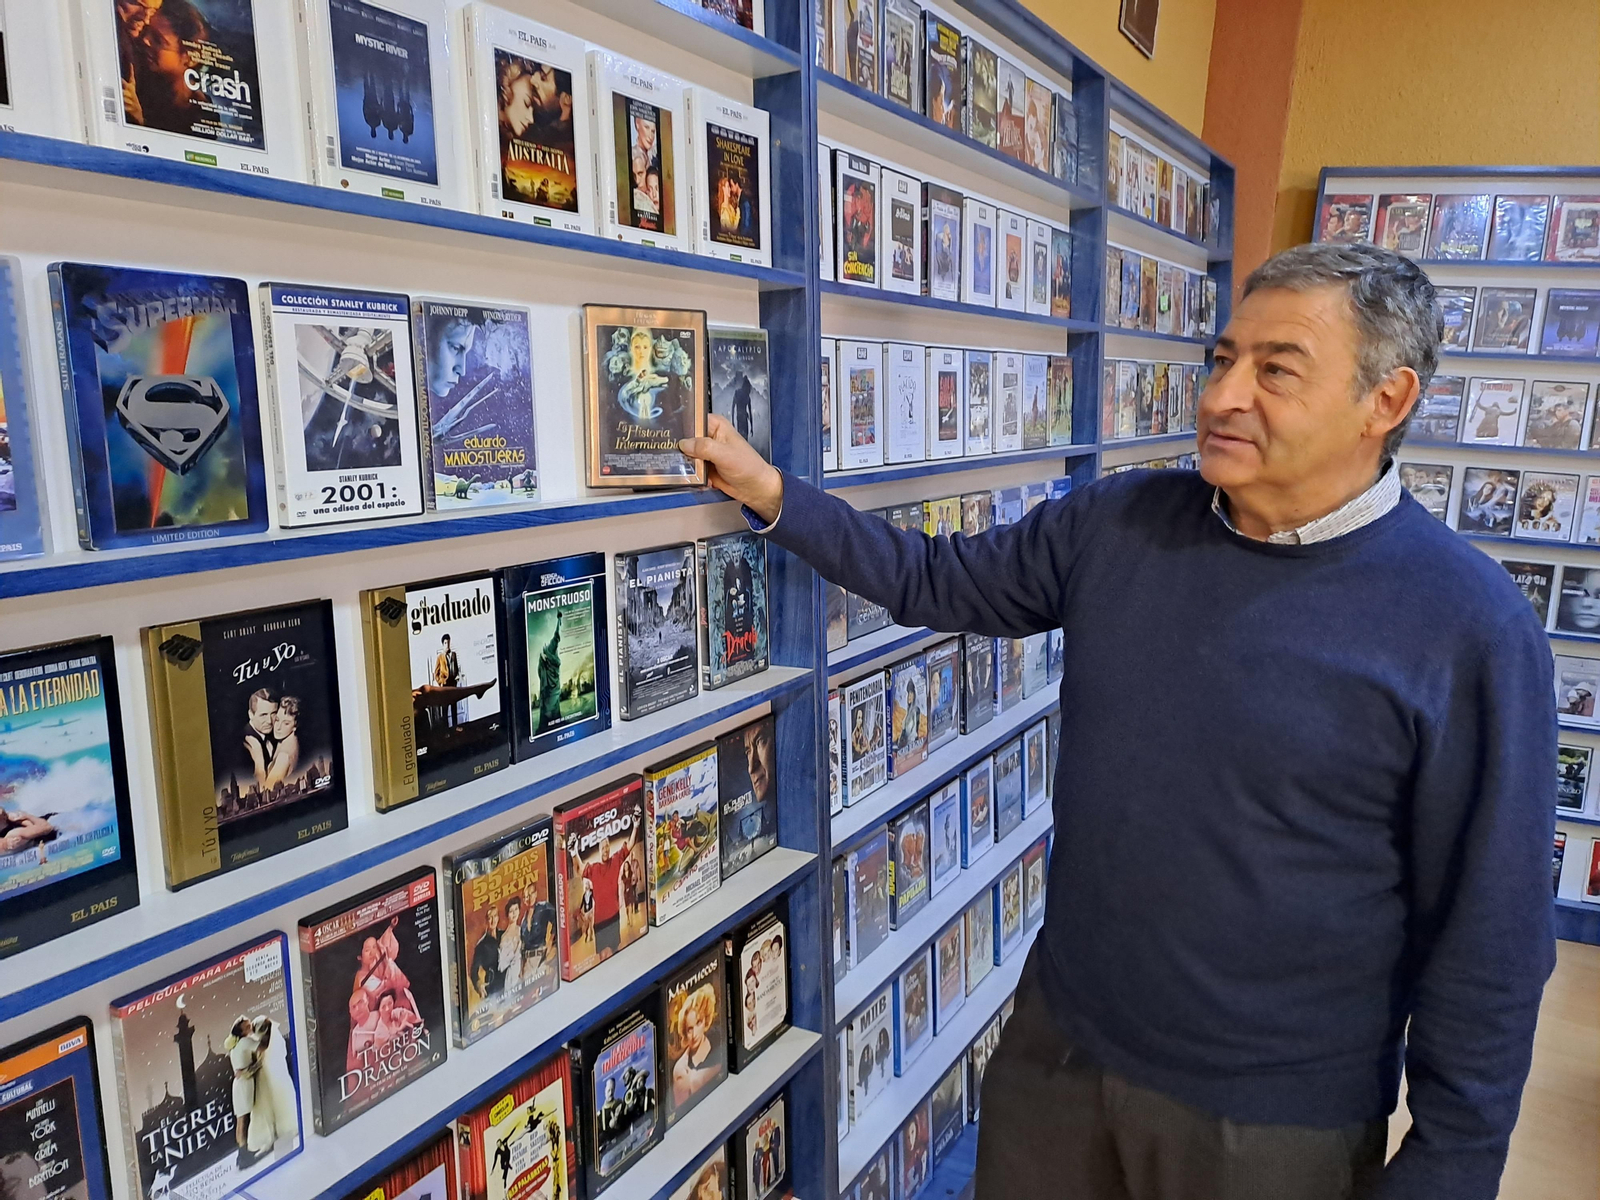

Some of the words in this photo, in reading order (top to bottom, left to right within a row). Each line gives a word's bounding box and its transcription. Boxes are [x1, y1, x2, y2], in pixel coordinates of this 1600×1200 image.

[355, 33, 385, 52] MYSTIC
[386, 43, 408, 59] RIVER
[518, 30, 529, 42] EL
[184, 69, 251, 103] crash
[240, 163, 251, 172] EL
[507, 140, 570, 176] AUSTRALIA
[281, 295, 329, 306] COLECCIÓN
[331, 300, 364, 309] STANLEY
[366, 301, 398, 312] KUBRICK
[429, 304, 454, 317] JOHNNY
[453, 307, 468, 317] DEPP
[81, 293, 237, 354] SUPERMAN
[54, 321, 70, 391] SUPERMAN
[464, 434, 507, 449] eduardo
[321, 482, 397, 505] 2001:
[313, 506, 330, 515] una
[332, 504, 360, 513] odisea
[362, 502, 375, 510] del
[377, 498, 405, 511] espacio
[152, 532, 185, 543] LIMITED
[187, 529, 220, 539] EDITION
[629, 578, 642, 588] EL
[647, 566, 693, 586] PIANISTA
[411, 588, 491, 635] graduado
[528, 590, 590, 613] MONSTRUOSO
[262, 657, 270, 670] y
[9, 684, 29, 715] LA
[30, 669, 100, 711] ETERNIDAD
[849, 679, 882, 706] PENITENCIARIA
[401, 715, 416, 772] graduado
[315, 775, 331, 787] DVD
[403, 776, 415, 786] El
[473, 765, 484, 775] EL
[658, 782, 676, 800] GENE
[675, 774, 692, 793] KELLY
[594, 808, 617, 828] PESO
[297, 828, 310, 839] EL
[532, 828, 549, 842] DVD
[581, 814, 631, 852] PESADO
[472, 868, 502, 898] 55
[504, 850, 539, 876] DIAS
[513, 865, 532, 879] EN
[413, 881, 430, 895] DVD
[473, 870, 539, 912] PEKIN
[899, 879, 926, 908] PAPILLON
[71, 909, 88, 923] EL
[90, 896, 118, 915] PAIS
[314, 928, 322, 937] 4
[322, 920, 340, 934] OSCAR
[127, 982, 188, 1016] PELÍCULA
[192, 966, 222, 985] PARA
[60, 1038, 82, 1052] BBVA
[357, 1030, 410, 1069] TIGRE
[412, 1019, 424, 1038] &
[337, 1032, 431, 1103] DRAGON
[30, 1121, 56, 1141] YORK
[142, 1100, 217, 1154] TIGRE
[160, 1116, 171, 1128] EL
[150, 1151, 163, 1165] LA
[165, 1112, 234, 1168] NIEVE
